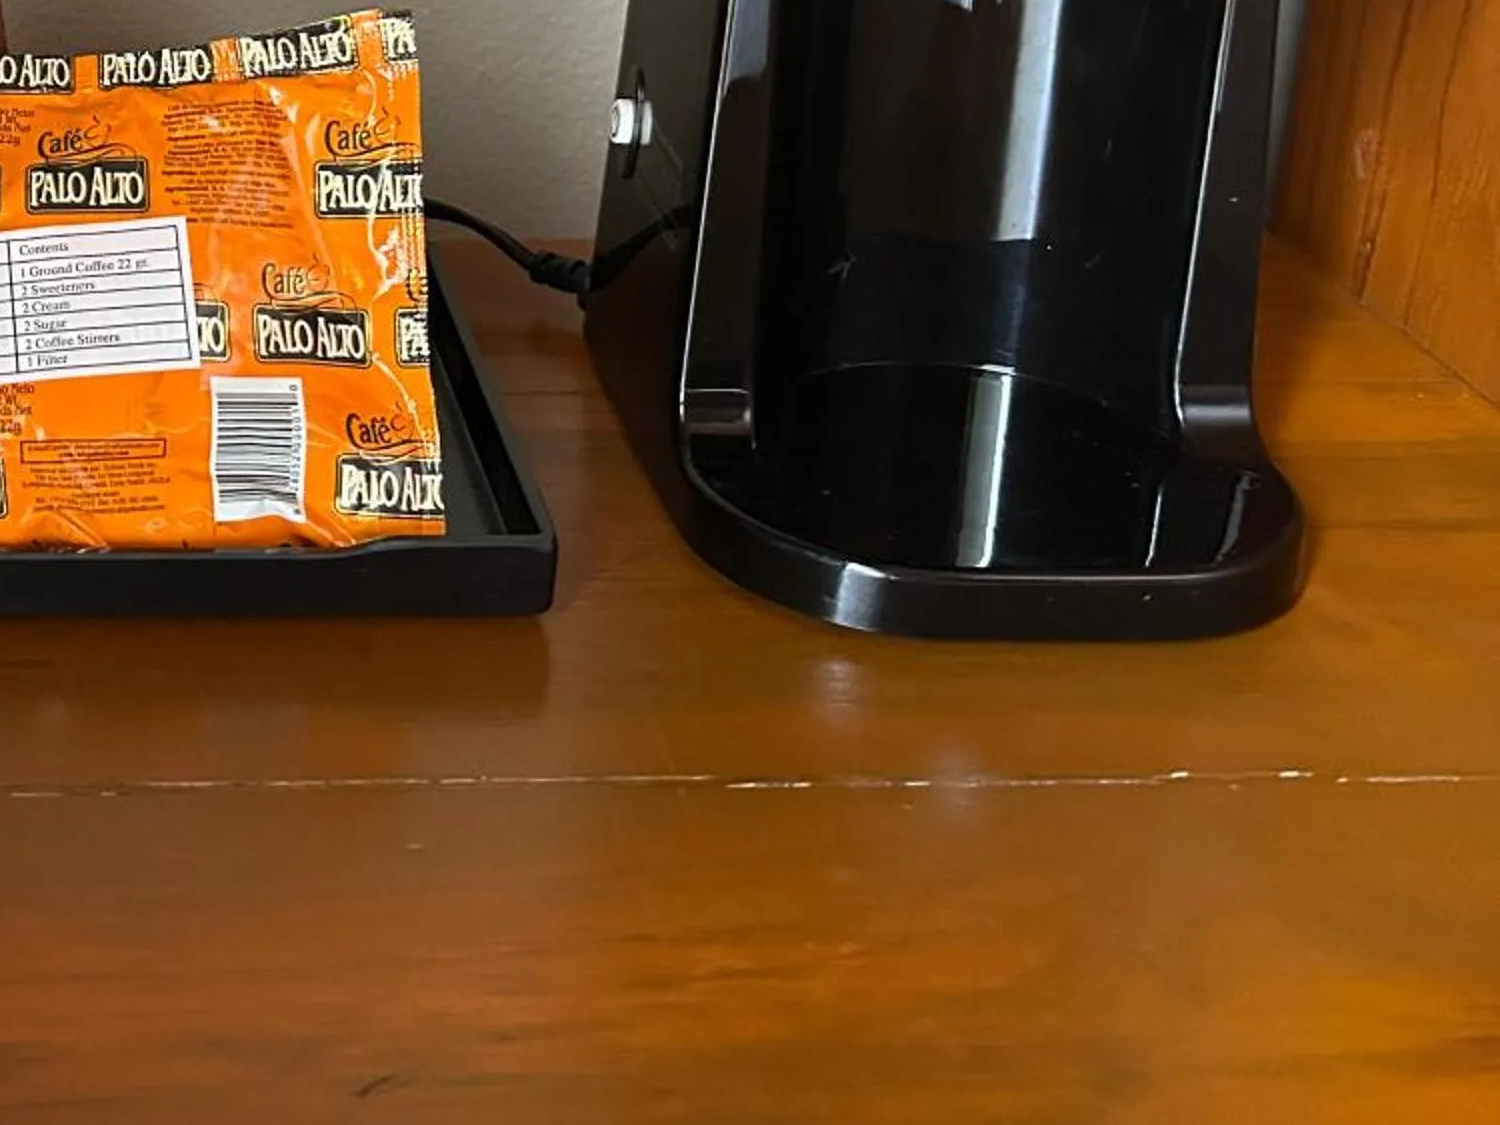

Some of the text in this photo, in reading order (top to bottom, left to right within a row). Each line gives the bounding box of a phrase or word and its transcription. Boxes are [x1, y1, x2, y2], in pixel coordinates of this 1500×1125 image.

[103, 49, 212, 85] PALO ALTO
[241, 29, 352, 75] PALO ALTO
[18, 53, 70, 88] ALTO
[38, 127, 83, 155] Café
[324, 120, 372, 154] Café
[30, 167, 144, 207] PALO ALTO
[318, 170, 378, 212] PALO
[19, 242, 69, 257] Contents
[30, 262, 73, 277] Ground
[75, 259, 115, 274] Coffee
[117, 258, 132, 270] 22
[262, 263, 304, 298] Café
[31, 281, 96, 296] Sweeteners
[32, 300, 71, 313] Cream
[33, 318, 68, 332] Sugar
[35, 335, 77, 349] Coffee
[257, 313, 366, 360] PALO ALTO
[37, 354, 69, 366] Filter
[346, 412, 392, 450] Café
[341, 463, 399, 509] PALO
